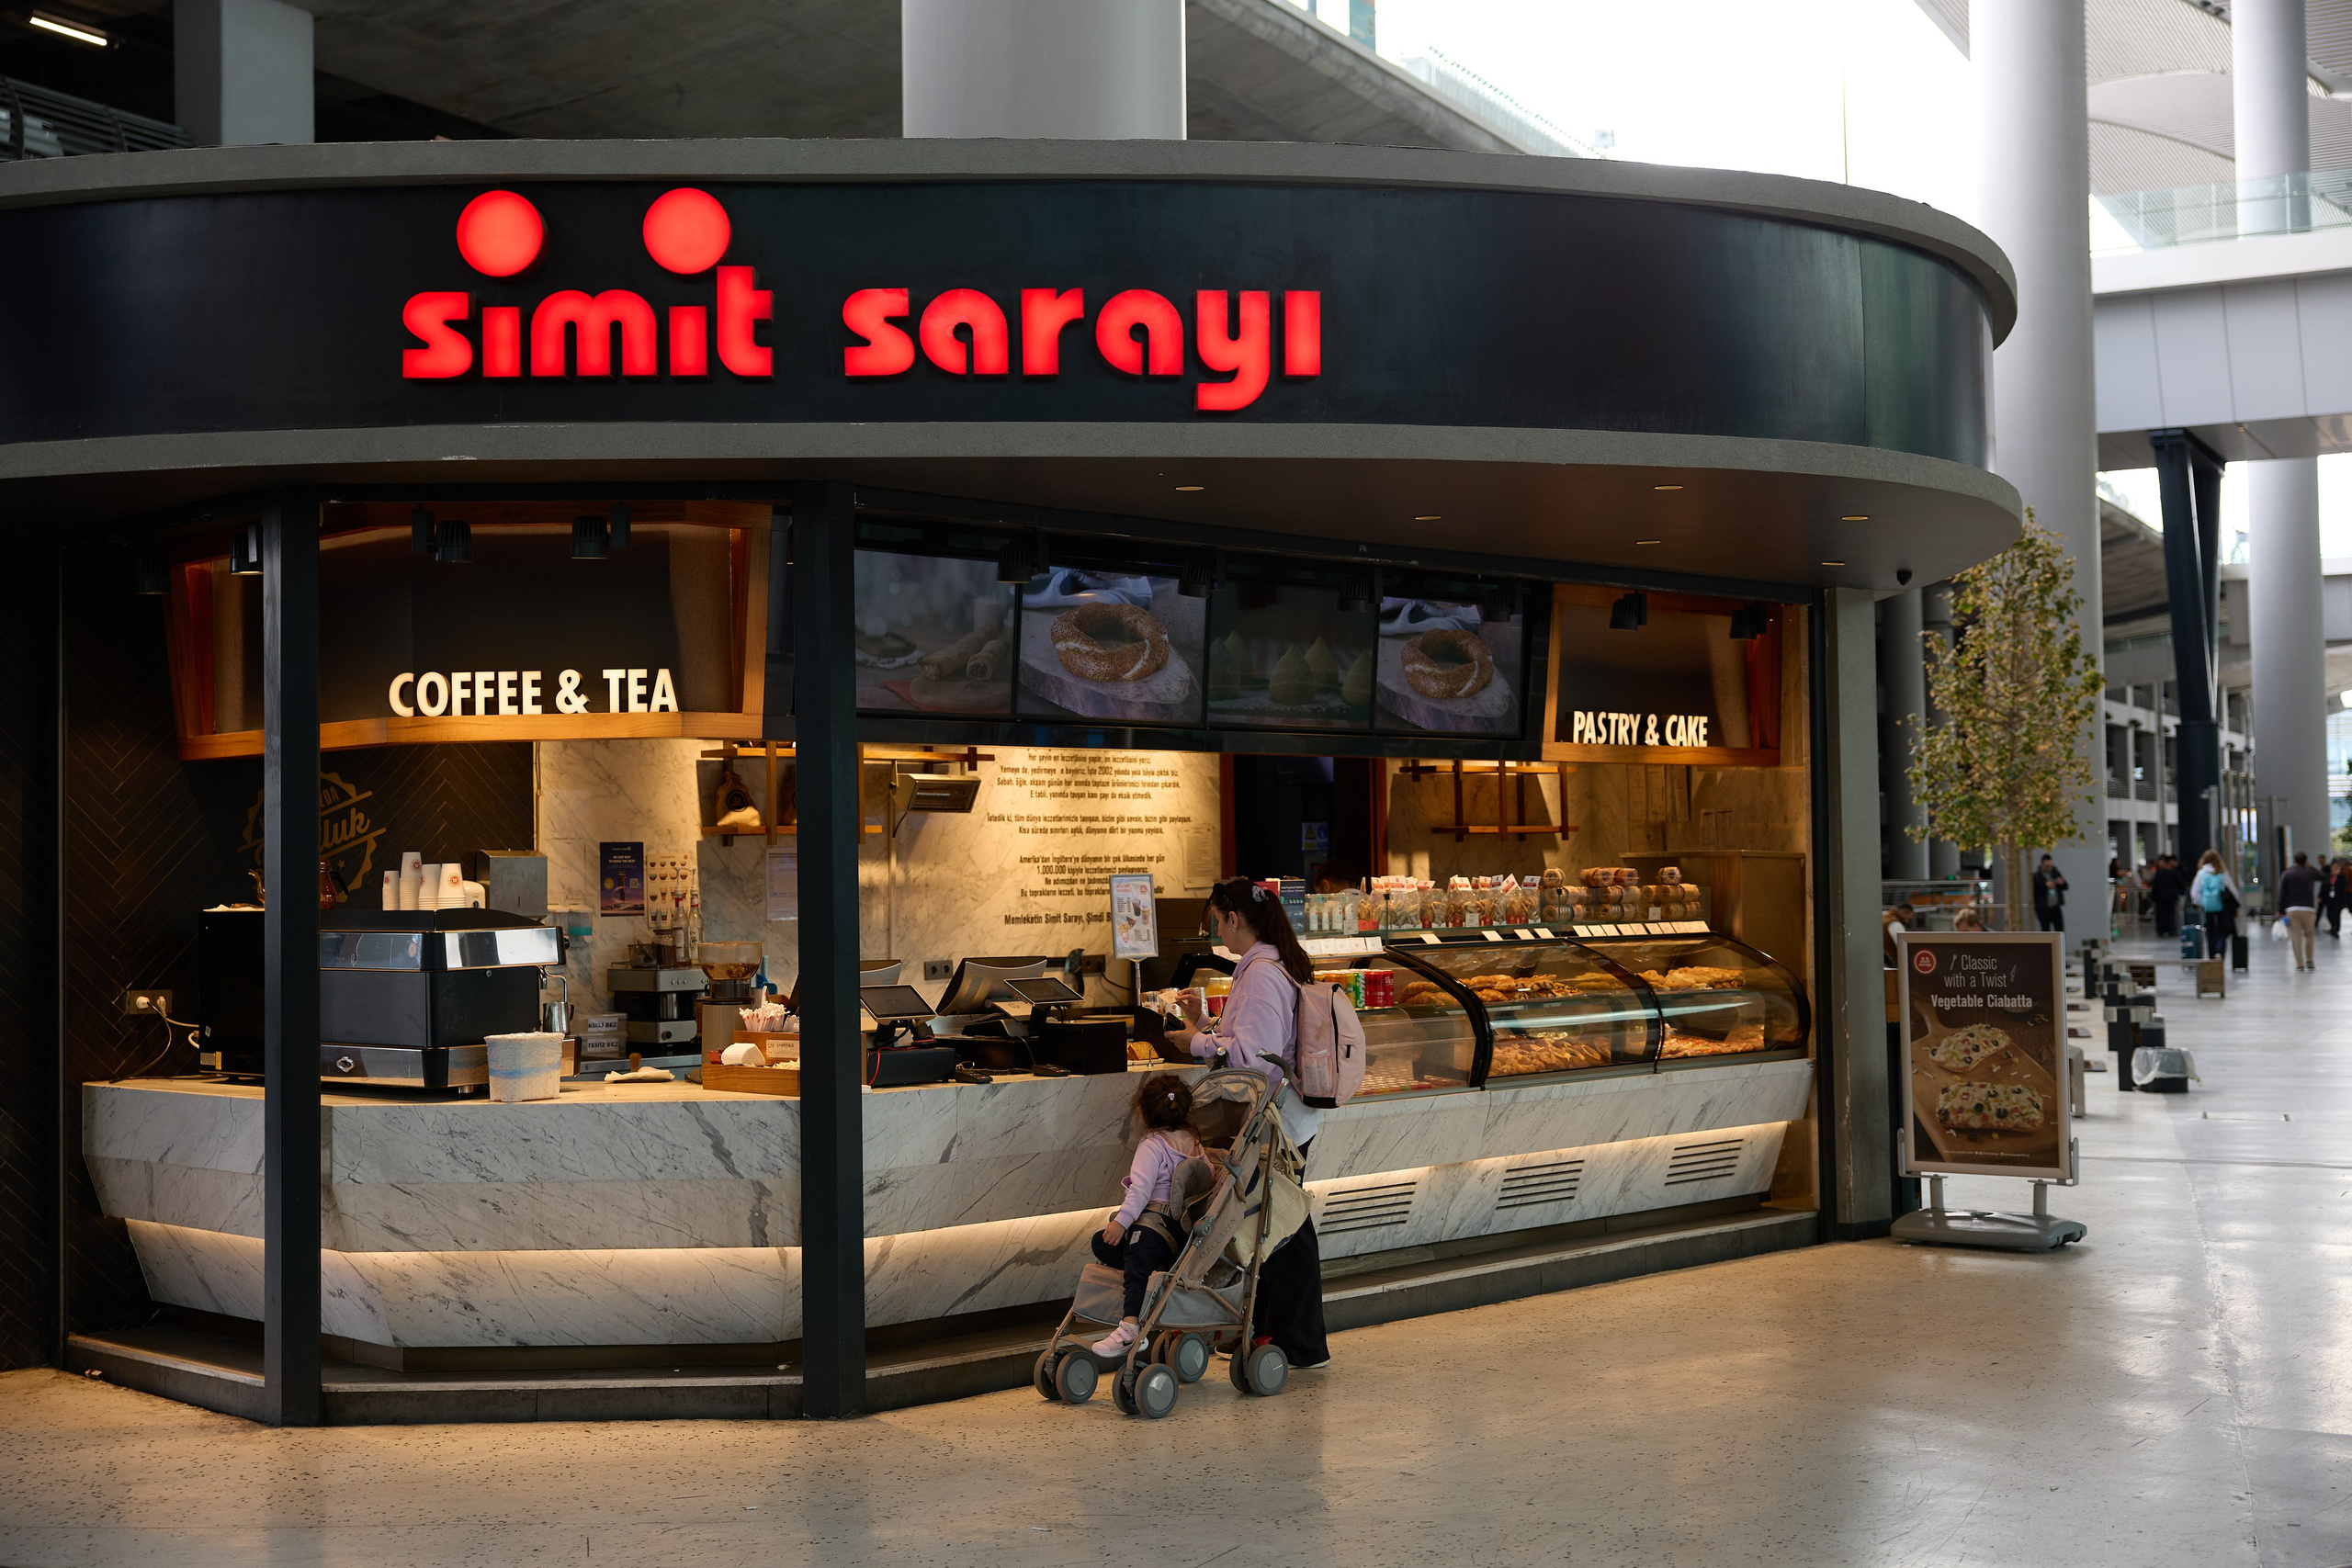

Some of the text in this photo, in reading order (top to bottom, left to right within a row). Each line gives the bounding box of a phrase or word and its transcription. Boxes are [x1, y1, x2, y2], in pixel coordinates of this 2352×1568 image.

[402, 187, 1321, 412] simit sarayı
[389, 668, 679, 717] COFFEE & TEA
[1572, 711, 1708, 747] PASTRY & CAKE
[1001, 766, 1020, 775] Yemeye
[1098, 766, 1113, 775] 2002
[1036, 865, 1066, 874] 1.000.000
[1021, 888, 1027, 897] Bu
[1004, 915, 1043, 925] Memleketin
[1045, 913, 1061, 924] Simit
[1087, 912, 1104, 924] Şimdi
[1961, 954, 1997, 970] Classic
[1944, 972, 2007, 987] with a Twist
[1931, 994, 2032, 1010] Vegetable Ciabatta
[1198, 1216, 1237, 1262] MACLAREN
